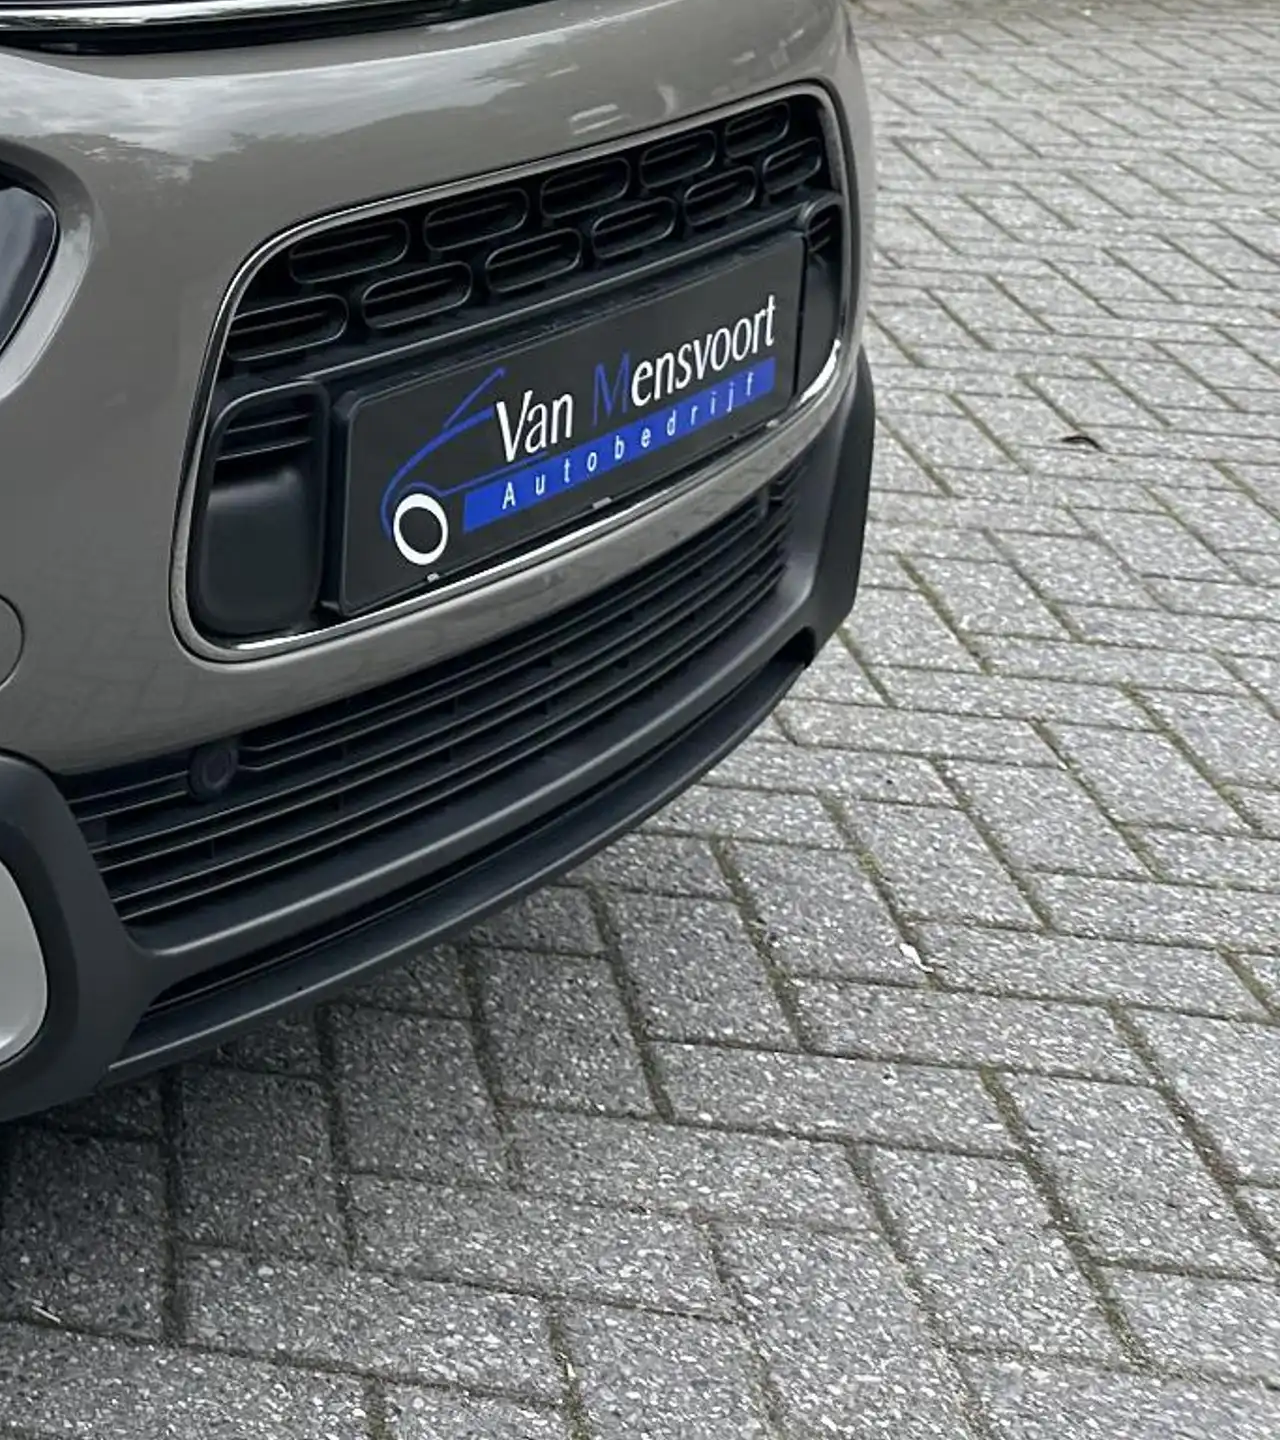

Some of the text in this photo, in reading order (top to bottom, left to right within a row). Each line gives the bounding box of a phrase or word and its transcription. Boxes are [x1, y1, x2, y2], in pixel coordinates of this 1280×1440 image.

[496, 294, 776, 463] Van Mensvoort
[502, 371, 755, 510] Autobedrijf
